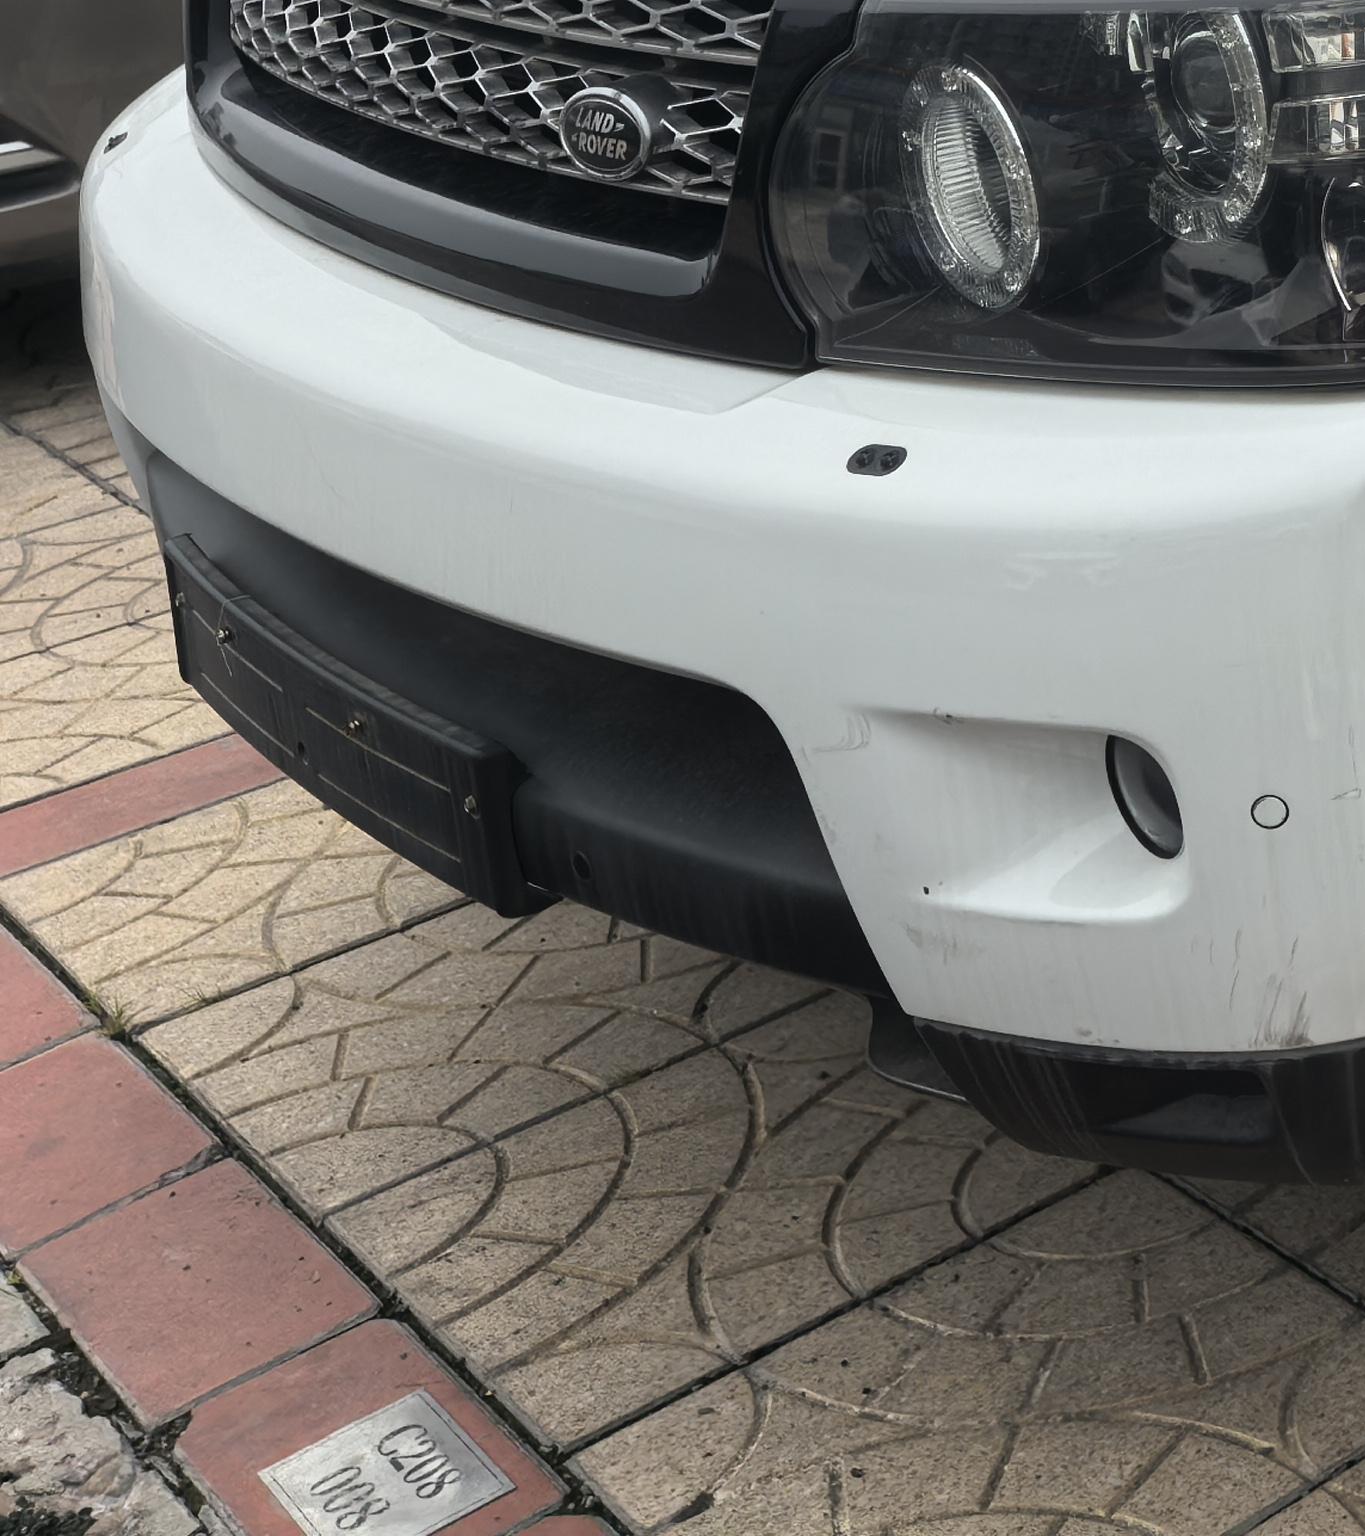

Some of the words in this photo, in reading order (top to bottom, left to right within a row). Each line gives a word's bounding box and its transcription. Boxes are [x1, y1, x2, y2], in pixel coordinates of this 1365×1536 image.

[575, 106, 615, 133] LAND
[578, 131, 628, 161] ROVER
[377, 1424, 461, 1499] C208
[310, 1466, 391, 1530] 008
